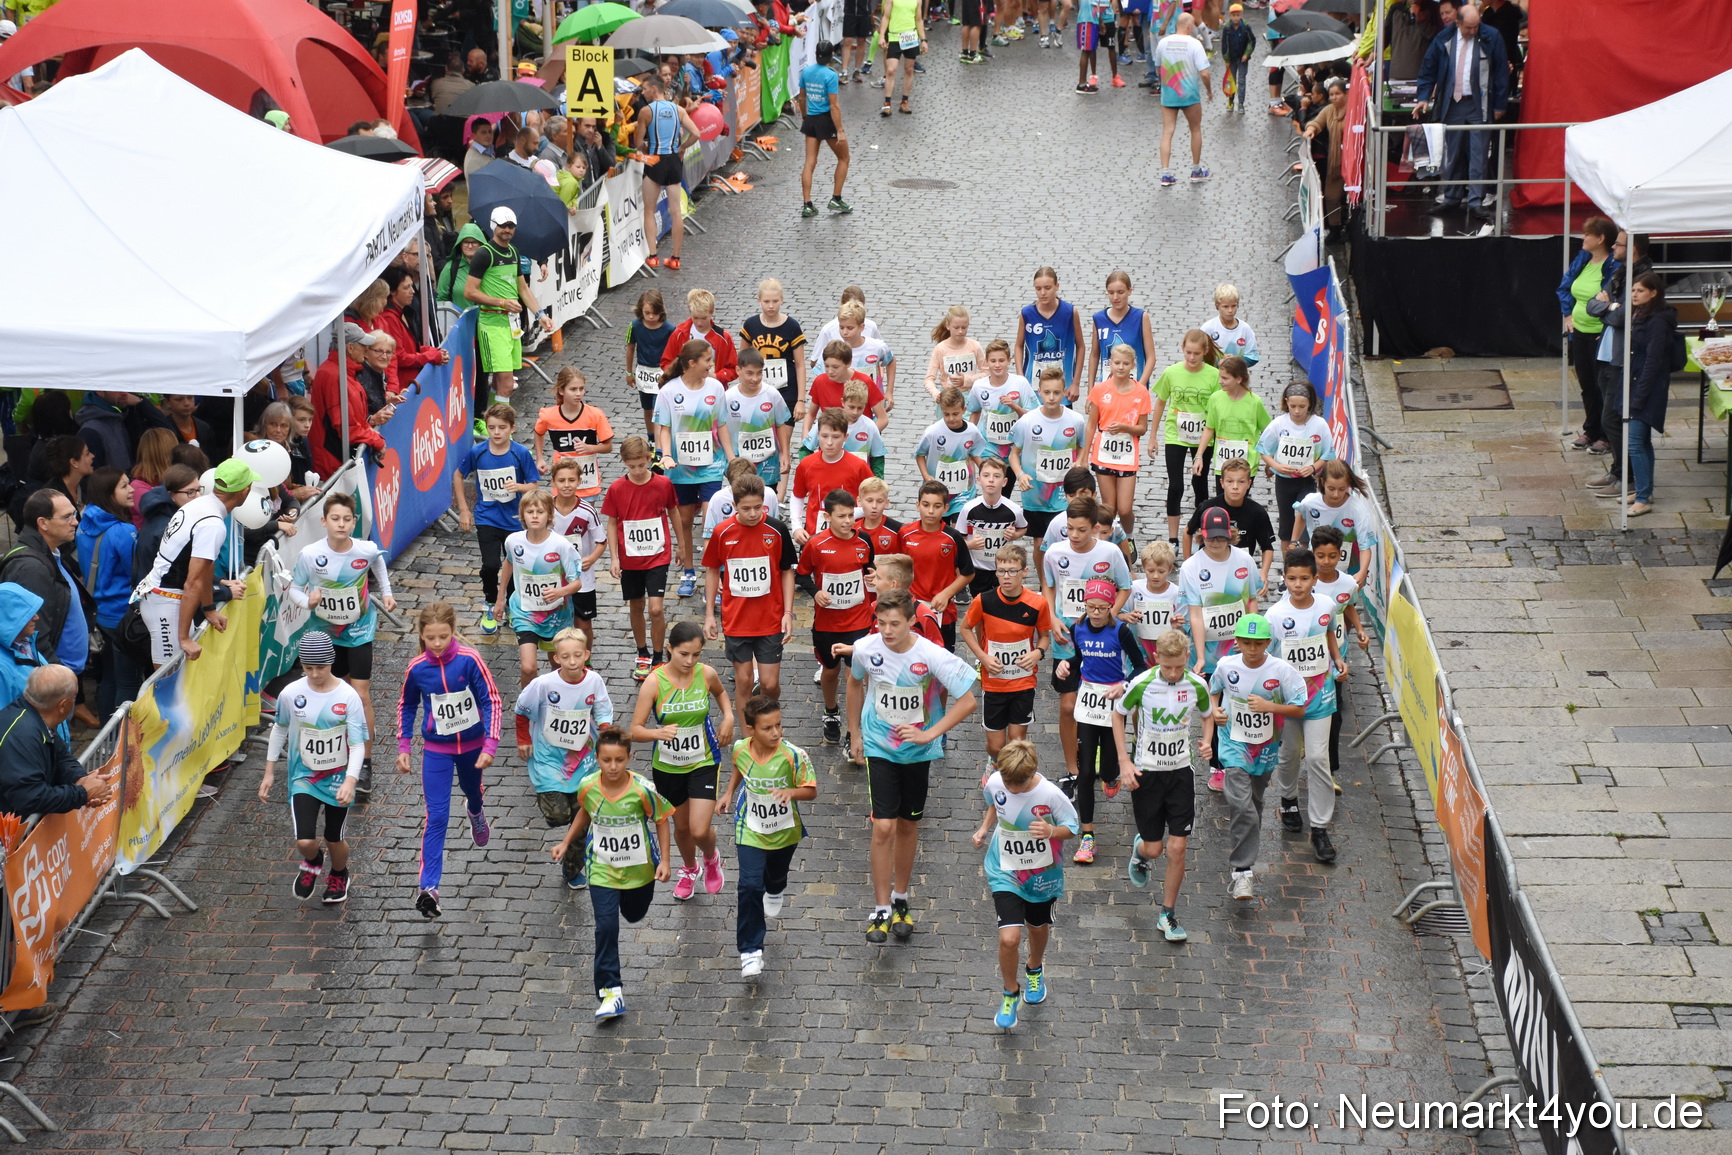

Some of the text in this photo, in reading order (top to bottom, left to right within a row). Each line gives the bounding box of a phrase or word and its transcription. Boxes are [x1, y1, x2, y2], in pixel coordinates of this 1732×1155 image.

[900, 34, 917, 44] 2002
[572, 49, 609, 62] Block
[577, 68, 604, 102] A
[1025, 323, 1043, 335] 66
[752, 333, 790, 352] OSAKA
[764, 366, 784, 379] 111
[948, 360, 974, 375] 4031
[1181, 420, 1206, 432] 4013
[413, 414, 445, 475] Hervis
[559, 433, 587, 447] sky
[680, 440, 710, 454] 4014
[742, 436, 772, 451] 4025
[1103, 439, 1133, 453] 4015
[1219, 447, 1244, 459] 4012
[1281, 444, 1312, 458] 4047
[582, 463, 595, 476] 44
[1040, 457, 1071, 471] 4102
[938, 468, 967, 482] 4110
[375, 467, 400, 532] Hervis
[628, 527, 660, 543] 4001
[733, 566, 767, 583] 4018
[827, 580, 860, 596] 4027
[1067, 588, 1085, 602] 40
[320, 596, 356, 611] 4016
[1209, 610, 1243, 630] 4008
[159, 617, 173, 658] skinfit
[1095, 641, 1105, 649] 21
[1287, 644, 1325, 663] 4034
[437, 696, 472, 719] 4019
[662, 700, 706, 714] BOCK
[880, 693, 920, 711] 4108
[1081, 692, 1114, 711] 4041
[445, 717, 469, 730] Samina
[550, 718, 587, 735] 4032
[1235, 712, 1270, 728] 4035
[305, 735, 343, 755] 4017
[559, 737, 575, 745] Luca
[663, 734, 700, 752] 4040
[1147, 739, 1184, 756] 4002
[313, 757, 336, 765] Tamina
[751, 801, 788, 819] 4048
[761, 820, 778, 829] Farid
[599, 834, 640, 852] 4049
[1004, 839, 1046, 855] 4046
[610, 855, 631, 863] Karim
